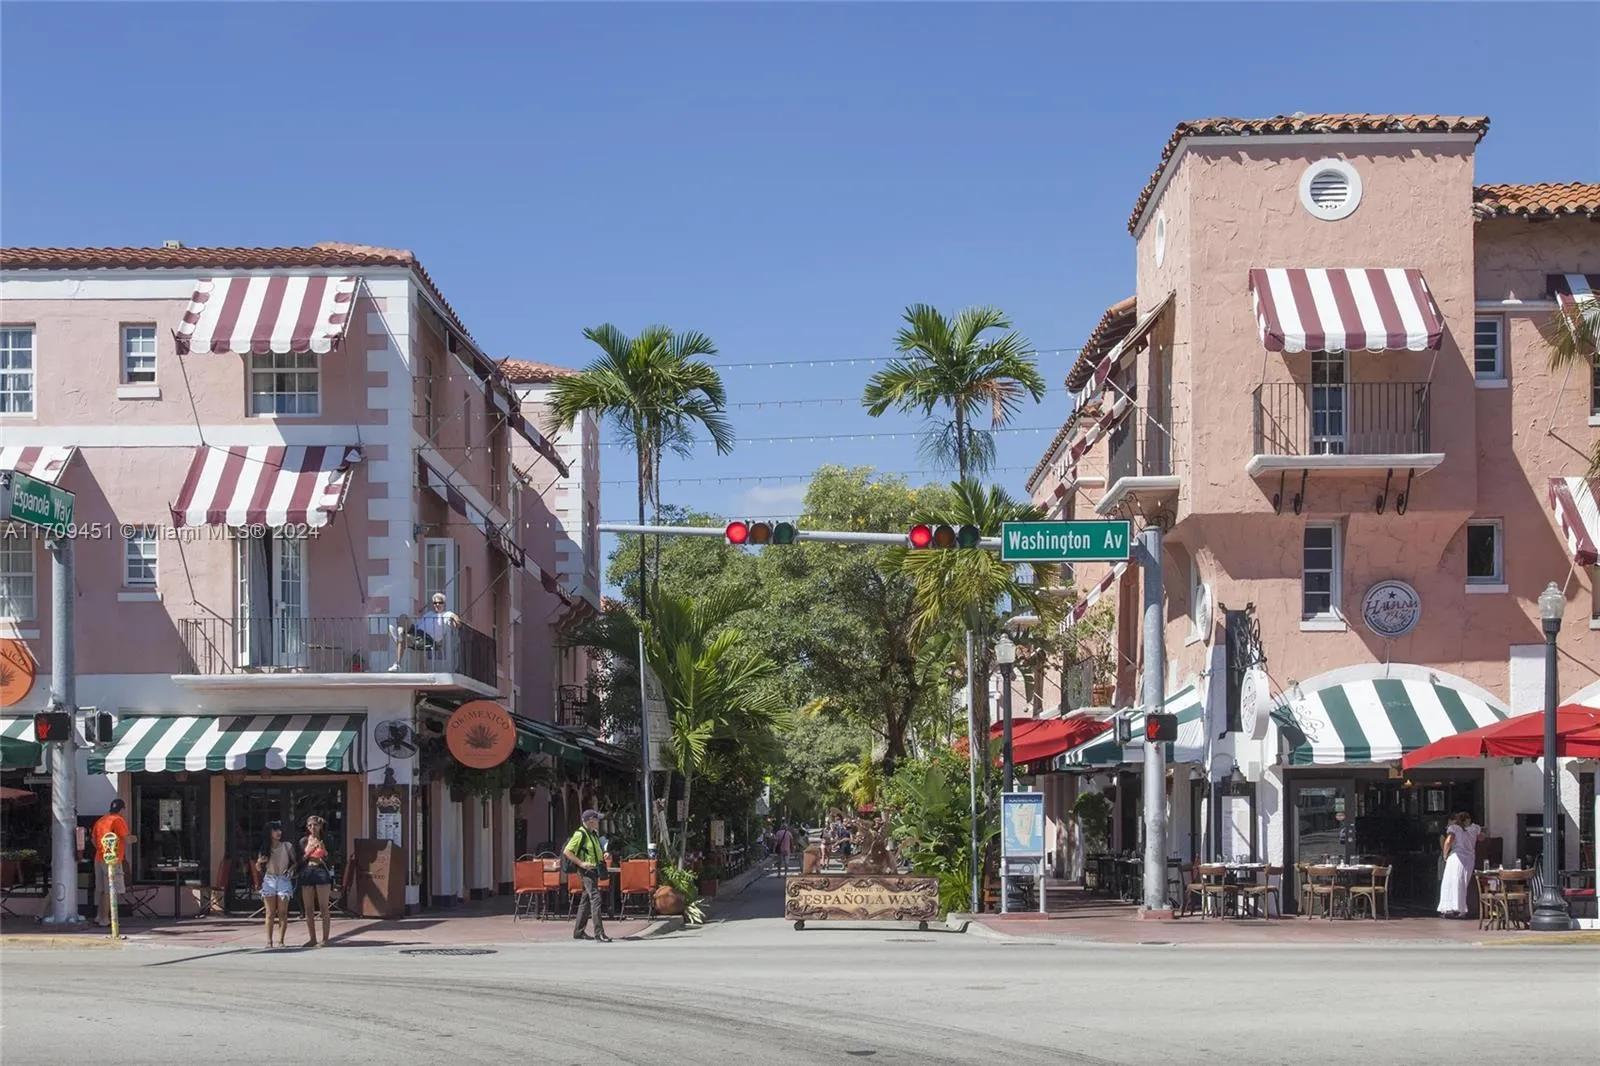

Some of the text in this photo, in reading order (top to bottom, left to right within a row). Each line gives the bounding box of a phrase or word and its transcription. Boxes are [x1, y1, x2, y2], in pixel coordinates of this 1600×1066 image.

[13, 484, 71, 526] Espanola Way
[1008, 529, 1123, 556] Washington Av
[803, 892, 923, 905] ESPAÑOLA WAY
